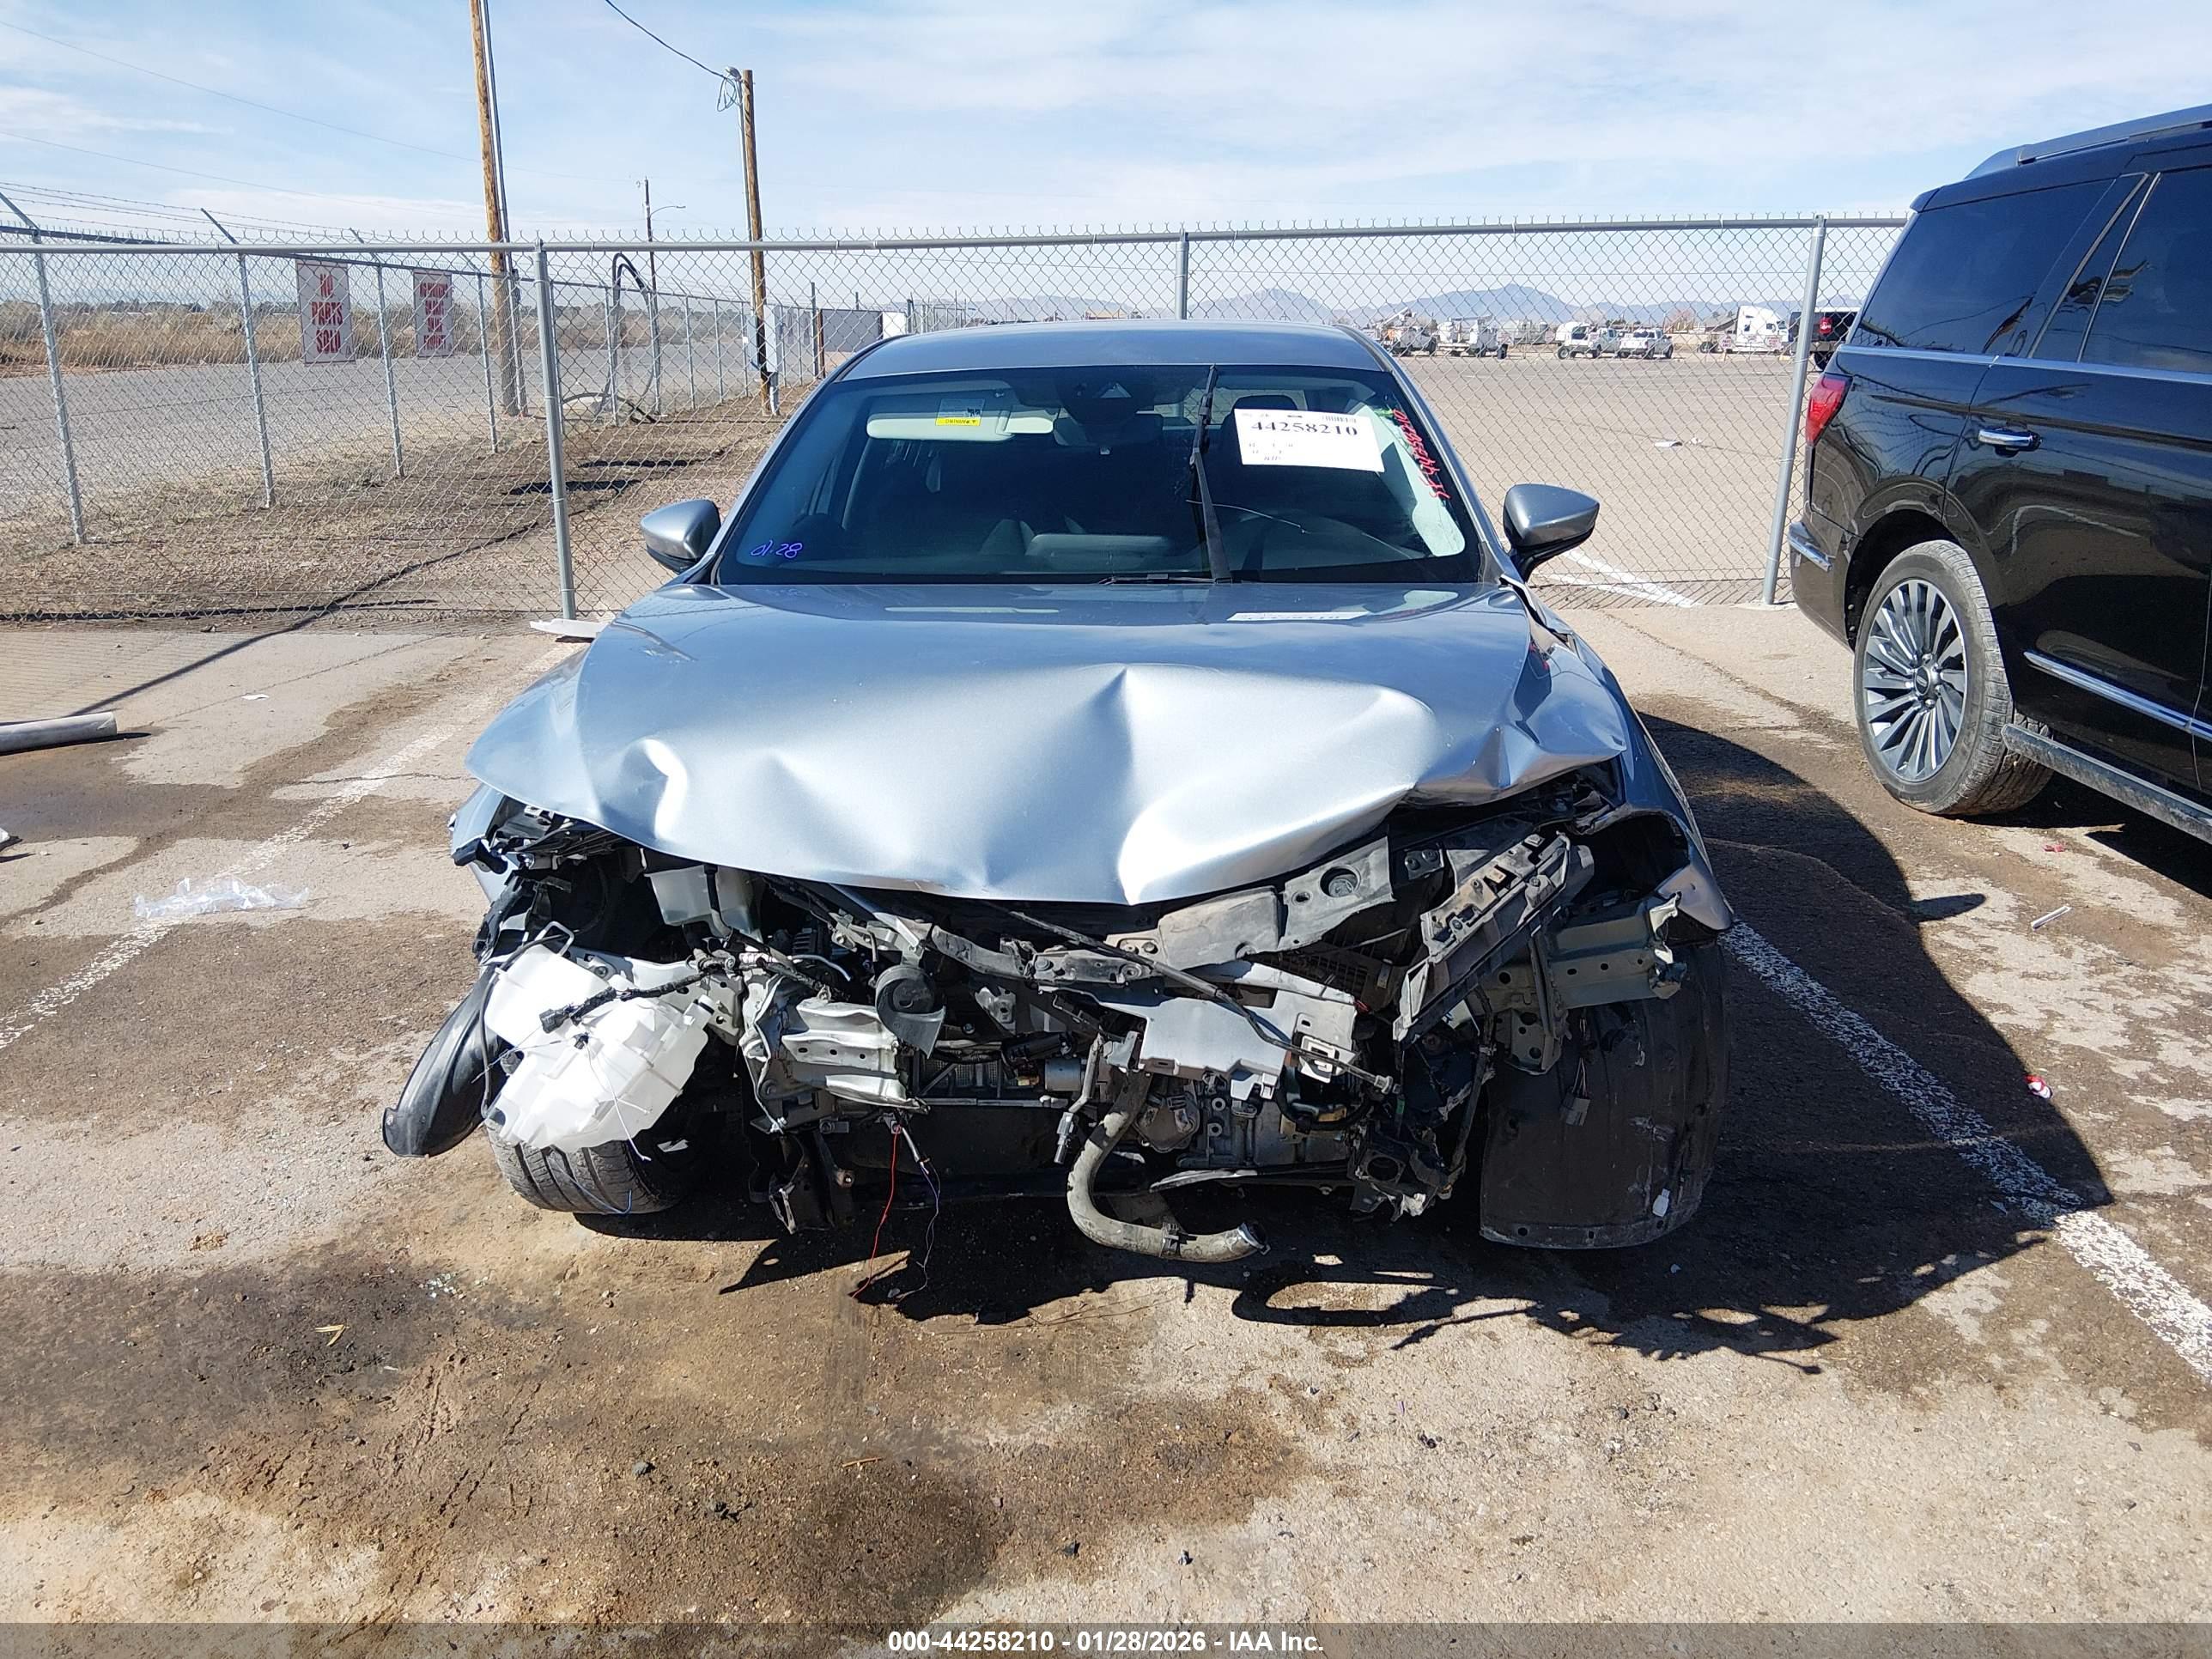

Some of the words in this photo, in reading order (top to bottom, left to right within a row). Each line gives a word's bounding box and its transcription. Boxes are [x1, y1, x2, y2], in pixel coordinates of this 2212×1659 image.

[320, 273, 334, 298] NO
[311, 301, 344, 326] PARTS
[316, 330, 342, 355] SOLD
[1251, 422, 1358, 435] 44258210
